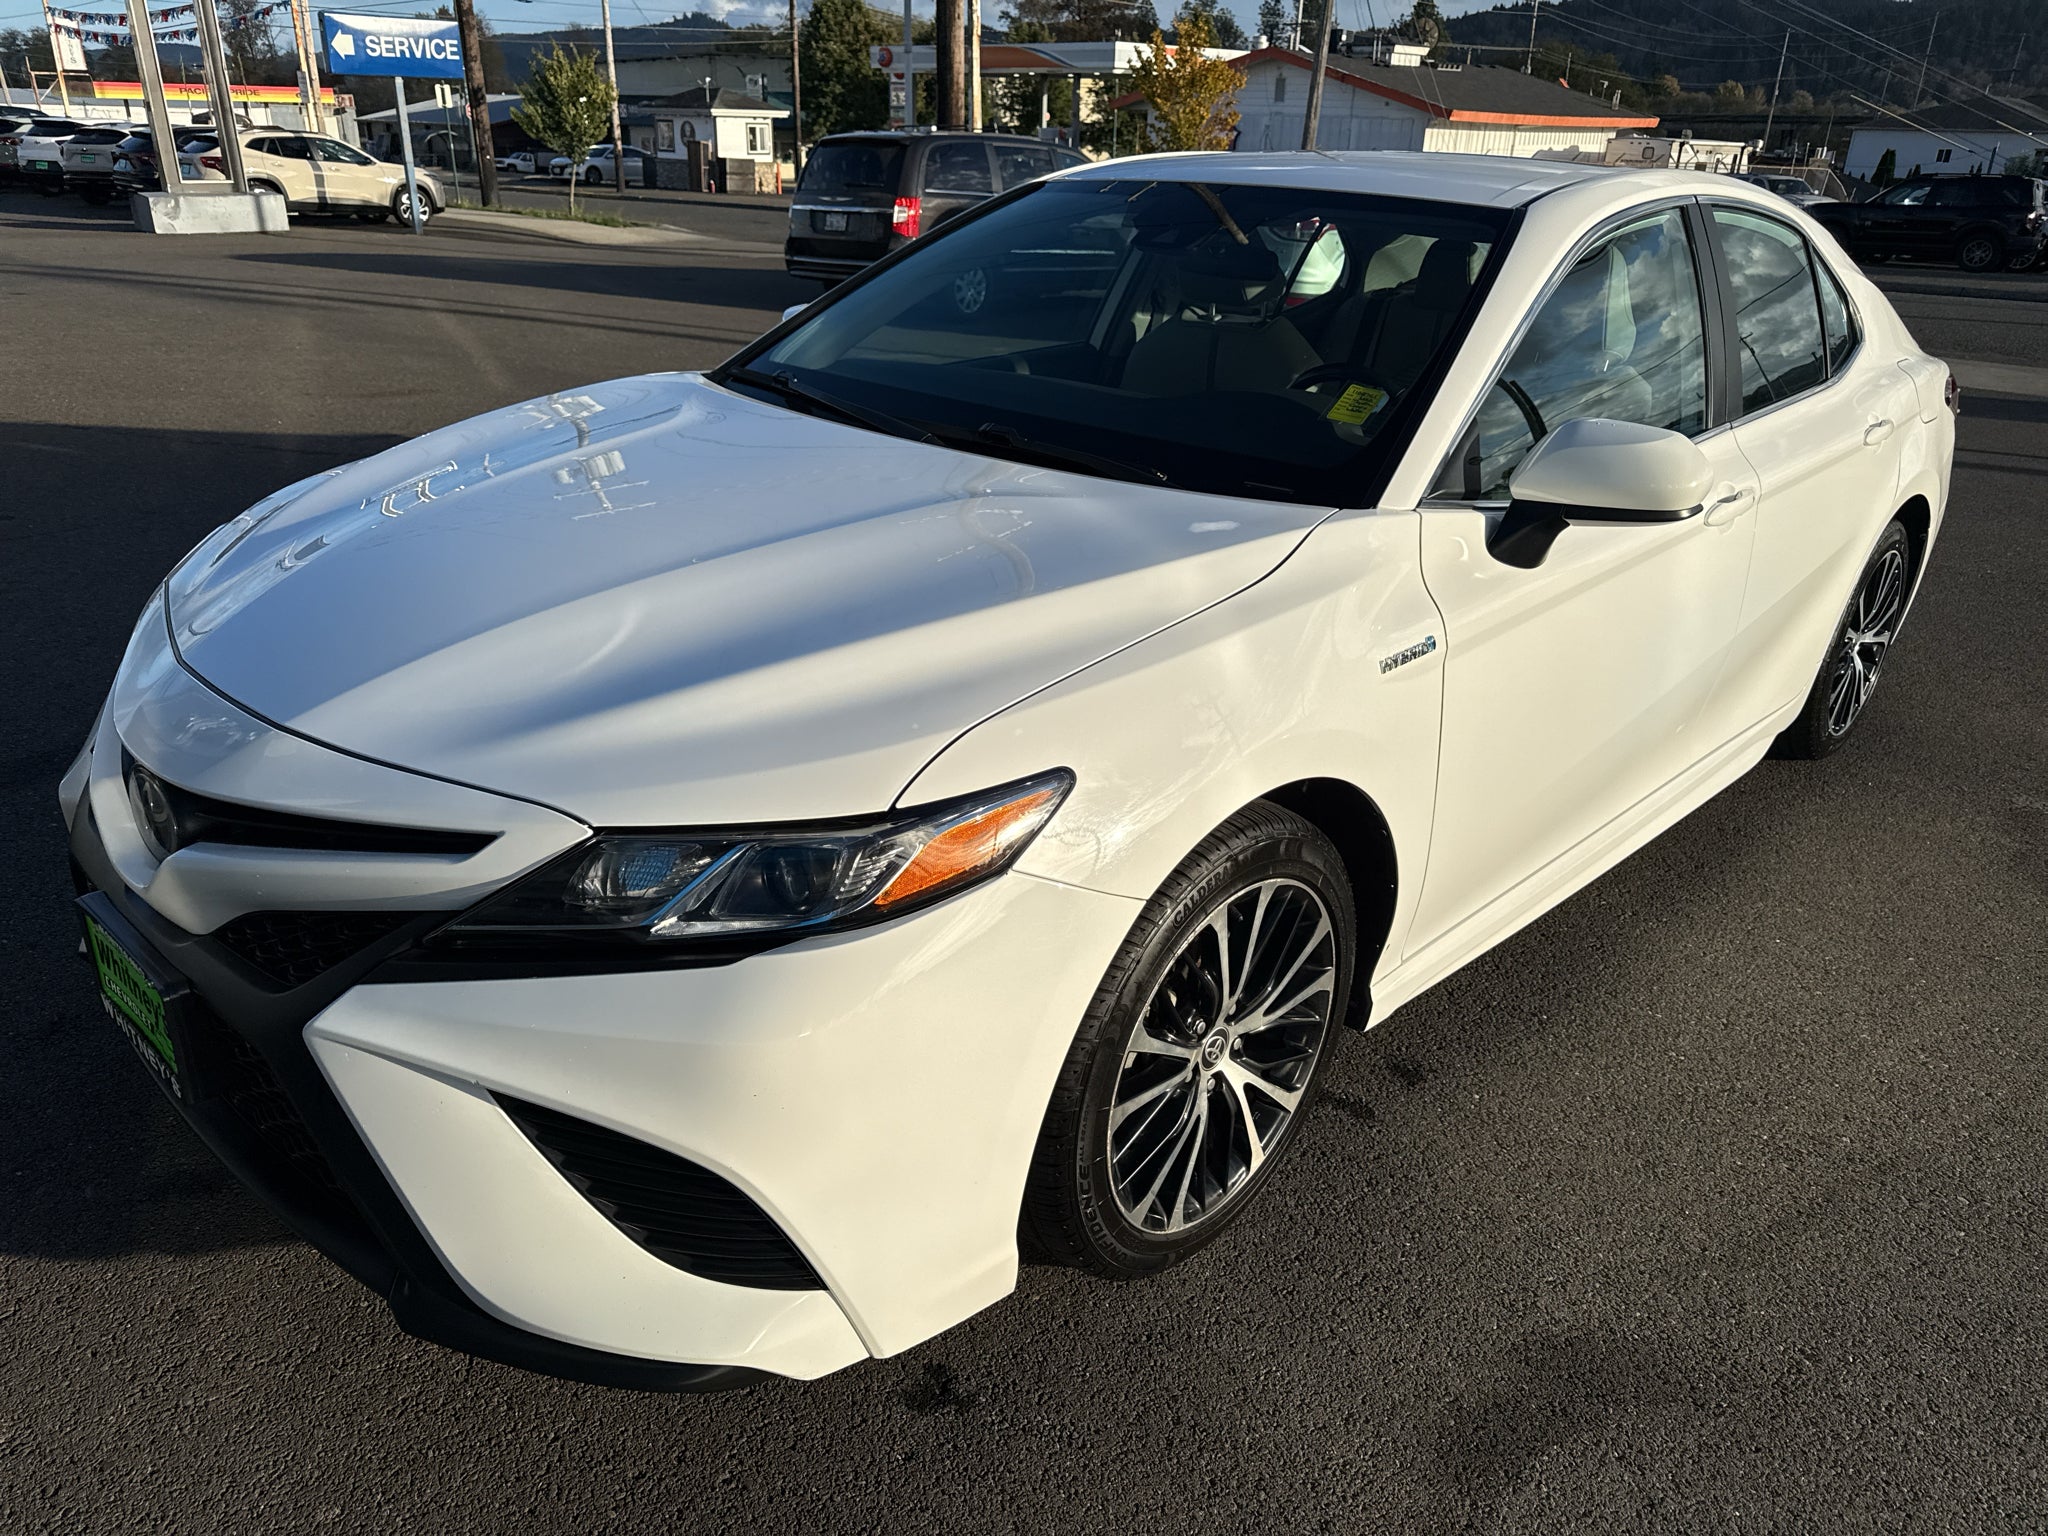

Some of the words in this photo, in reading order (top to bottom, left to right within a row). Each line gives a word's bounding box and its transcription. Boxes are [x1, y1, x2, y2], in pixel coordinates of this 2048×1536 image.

[365, 35, 460, 60] SERVICE
[1379, 641, 1430, 674] HYBRID
[95, 934, 163, 1034] Whitney
[104, 975, 152, 1029] CHEVROLET
